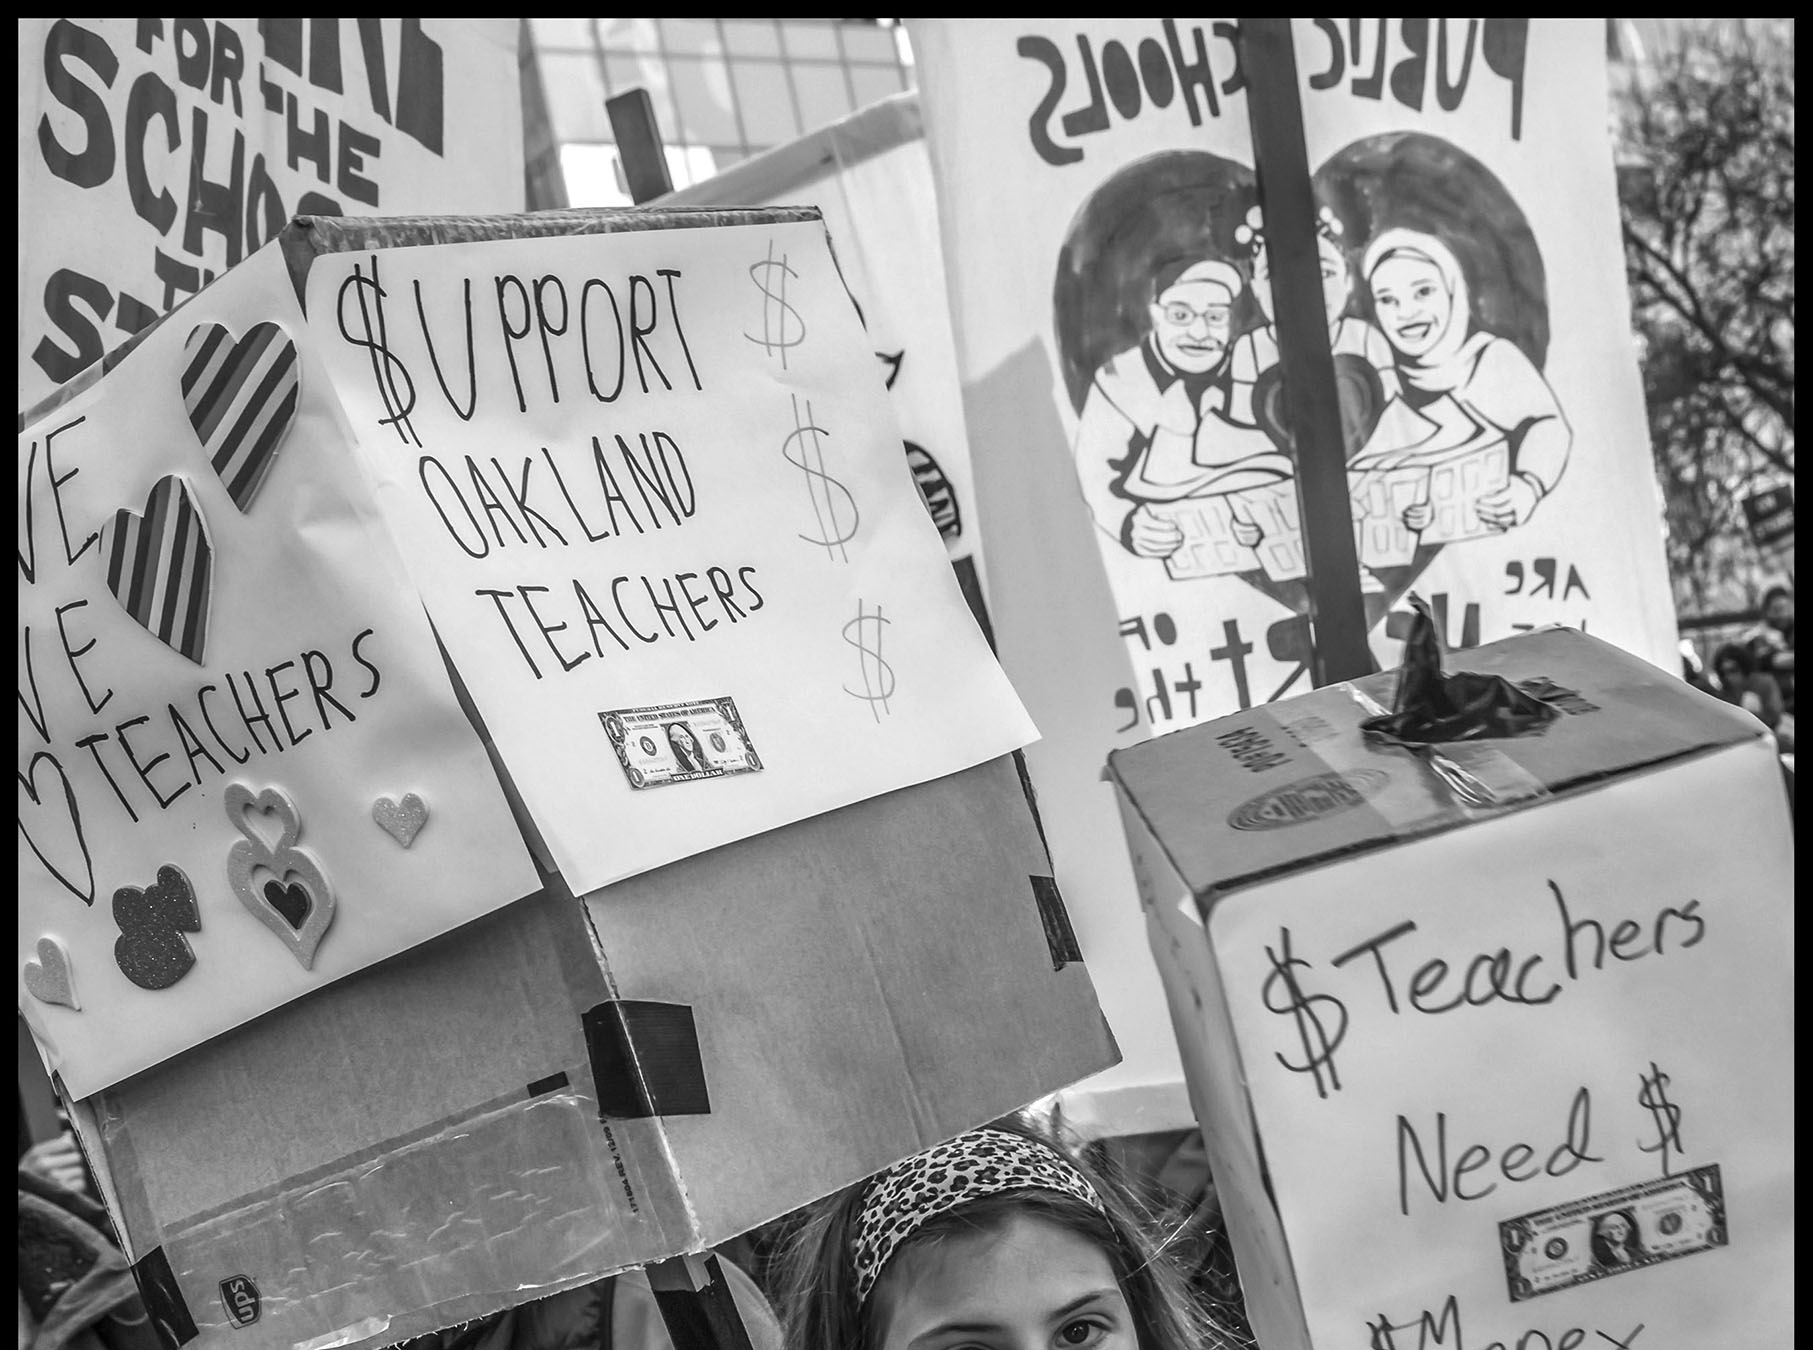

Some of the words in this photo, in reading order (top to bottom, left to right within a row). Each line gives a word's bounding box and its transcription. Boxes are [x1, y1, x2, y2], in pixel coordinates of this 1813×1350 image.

[338, 255, 703, 448] $UPPORT
[419, 431, 696, 559] OAKLAND
[475, 567, 765, 679] TEACHERS
[75, 628, 383, 823] TEACHERS
[691, 769, 724, 780] DOLLAR
[1398, 1087, 1605, 1216] Need
